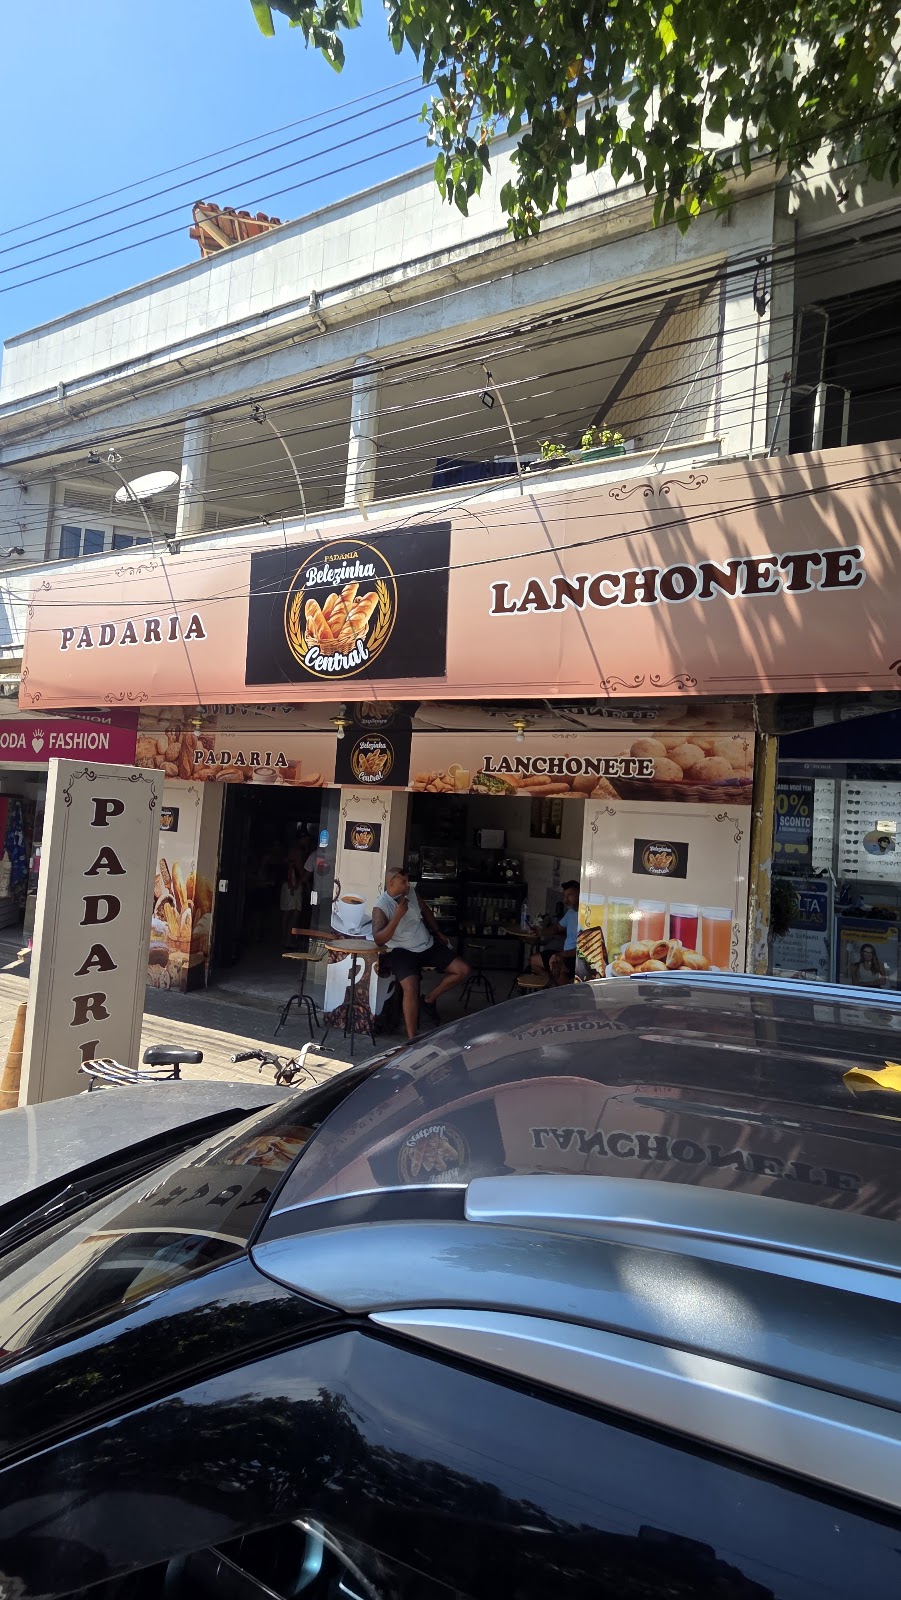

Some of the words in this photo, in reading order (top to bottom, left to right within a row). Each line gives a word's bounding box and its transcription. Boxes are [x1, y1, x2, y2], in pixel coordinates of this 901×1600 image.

[305, 561, 376, 586] Belezinha
[488, 544, 866, 616] LANCHONETE
[59, 613, 208, 652] PADARIA
[304, 638, 370, 671] Central
[0, 732, 27, 749] ODA
[49, 732, 110, 750] FASHION
[193, 750, 289, 768] PADARIA
[482, 755, 655, 779] LANCHONETE
